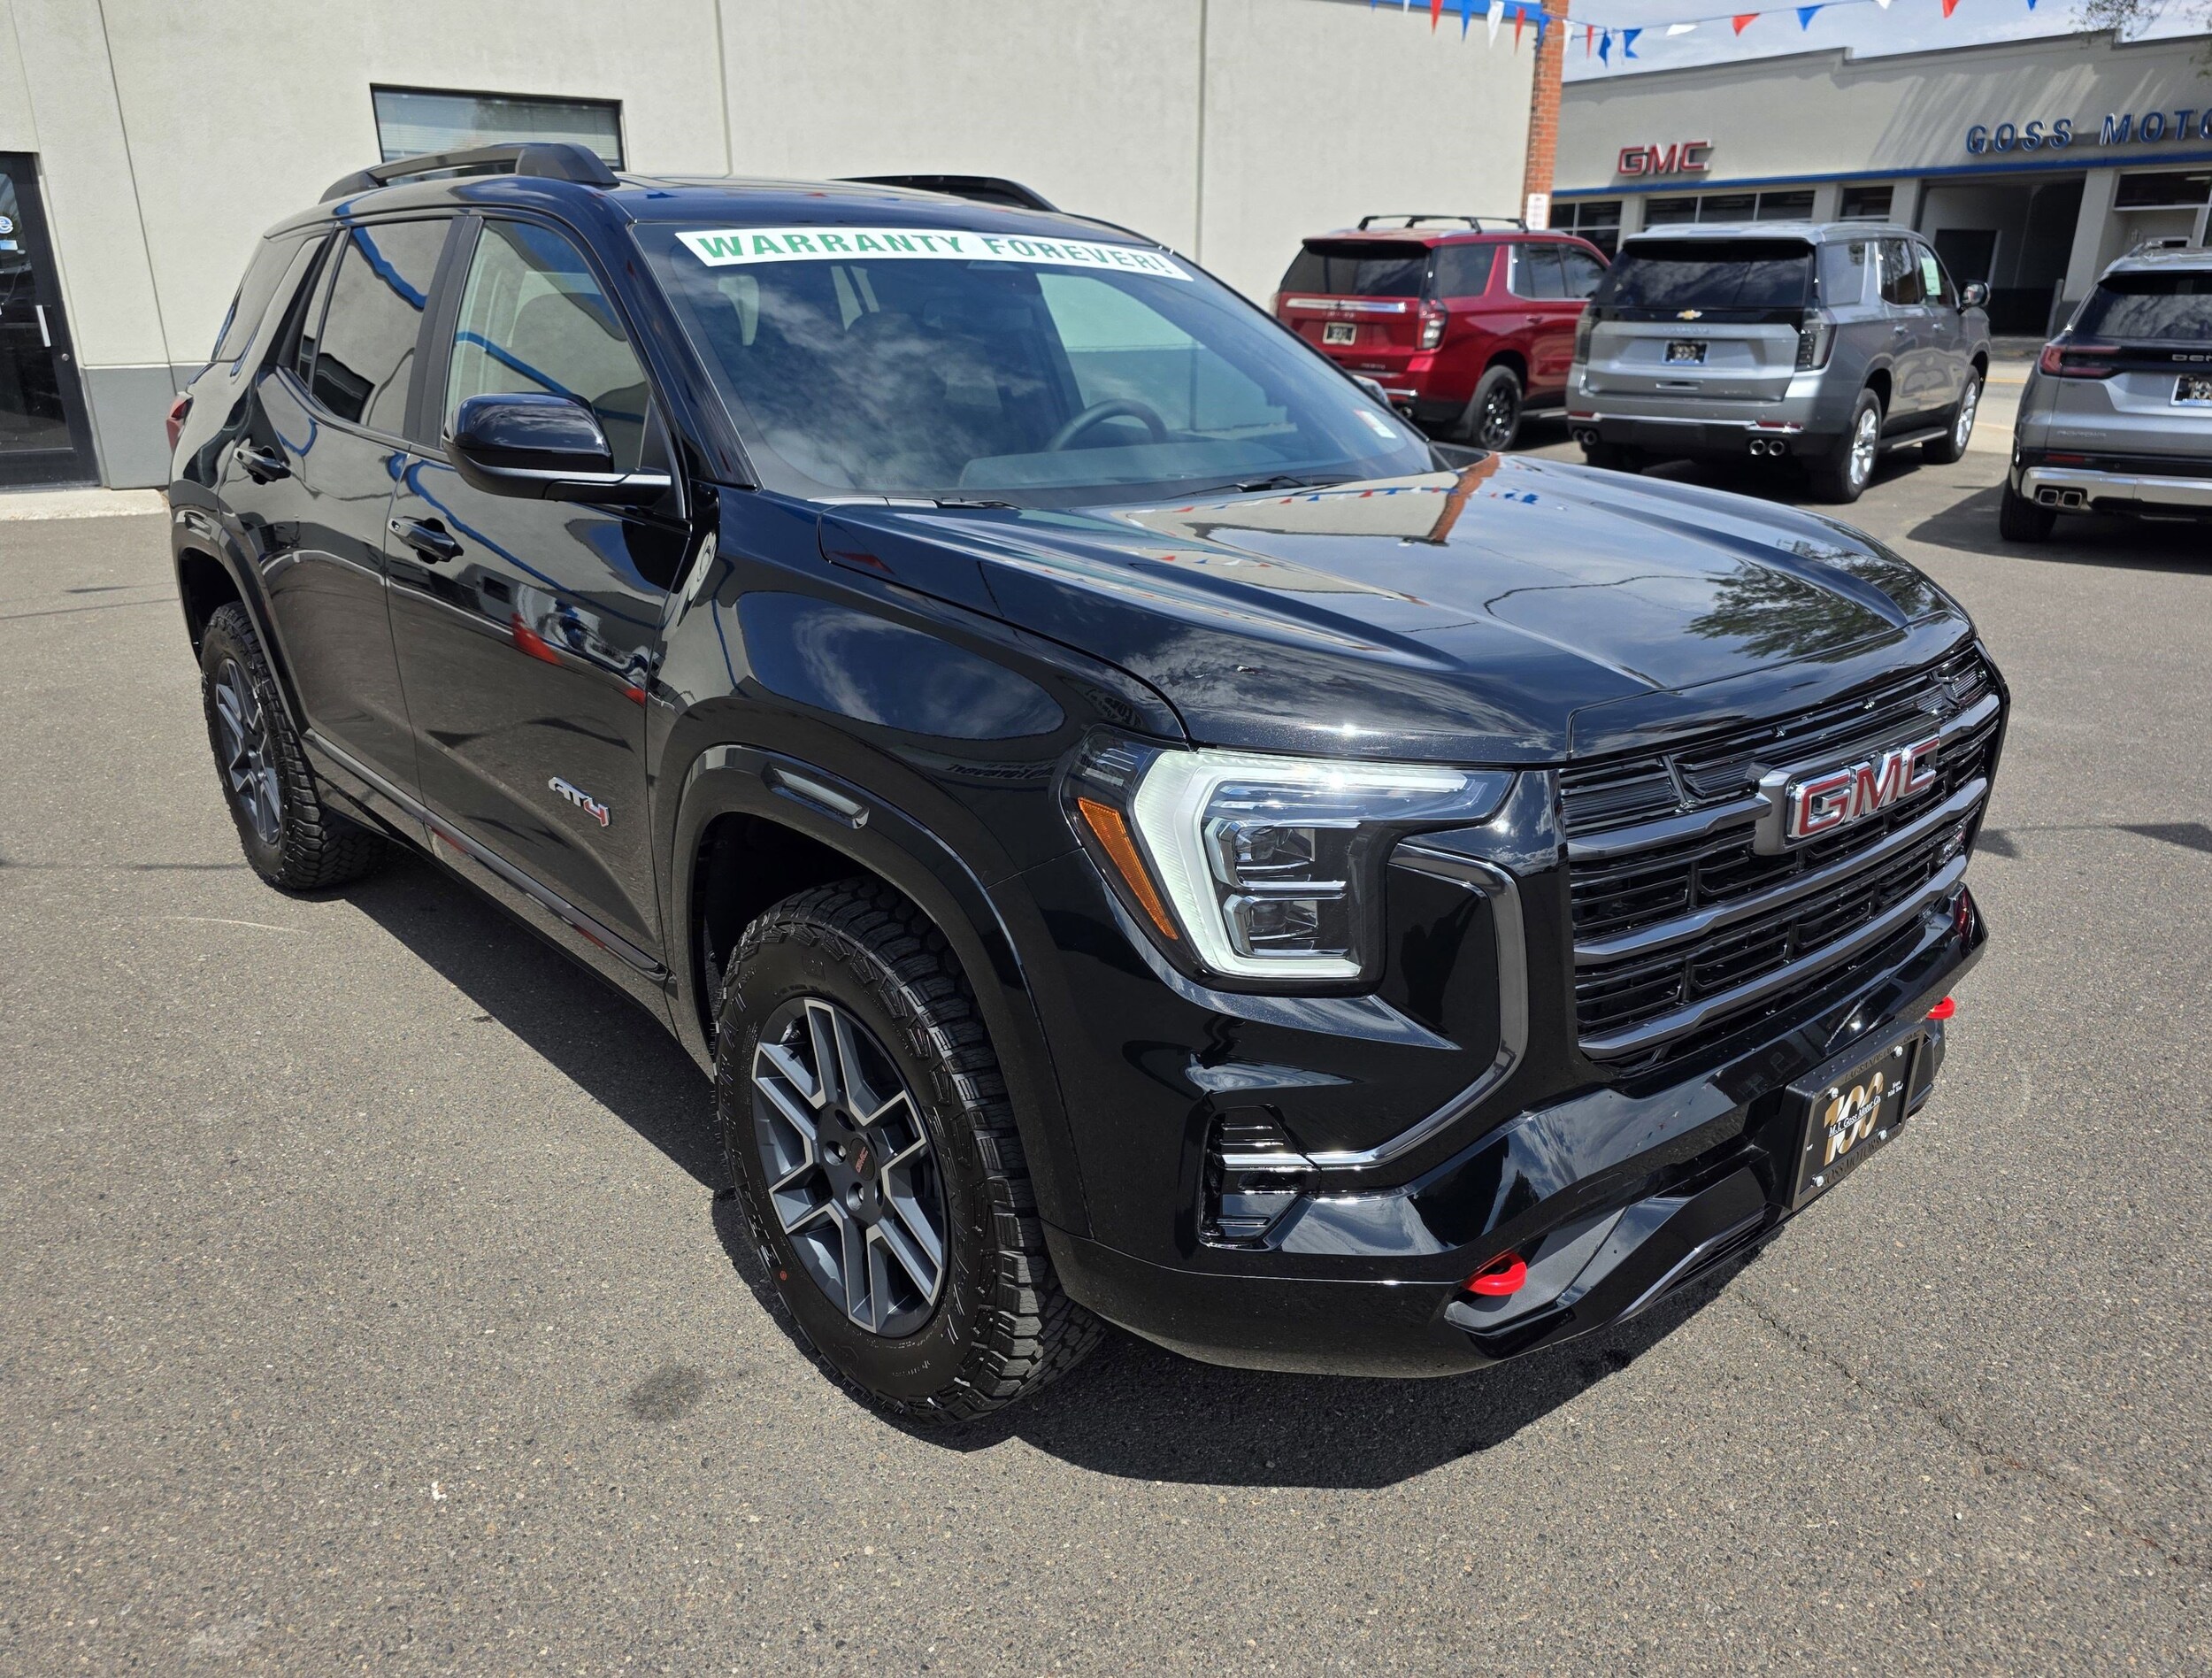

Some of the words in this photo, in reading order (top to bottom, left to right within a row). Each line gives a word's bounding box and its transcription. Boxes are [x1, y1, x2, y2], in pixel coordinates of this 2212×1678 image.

[1965, 119, 2073, 156] GOSS
[1618, 140, 1711, 176] GMC
[696, 234, 964, 258] WARRANTY
[981, 237, 1173, 274] FOREVER!
[549, 776, 609, 827] AT4
[1792, 735, 1939, 838] GMC
[1824, 1072, 1884, 1166] 100
[1843, 1114, 1858, 1128] Goss
